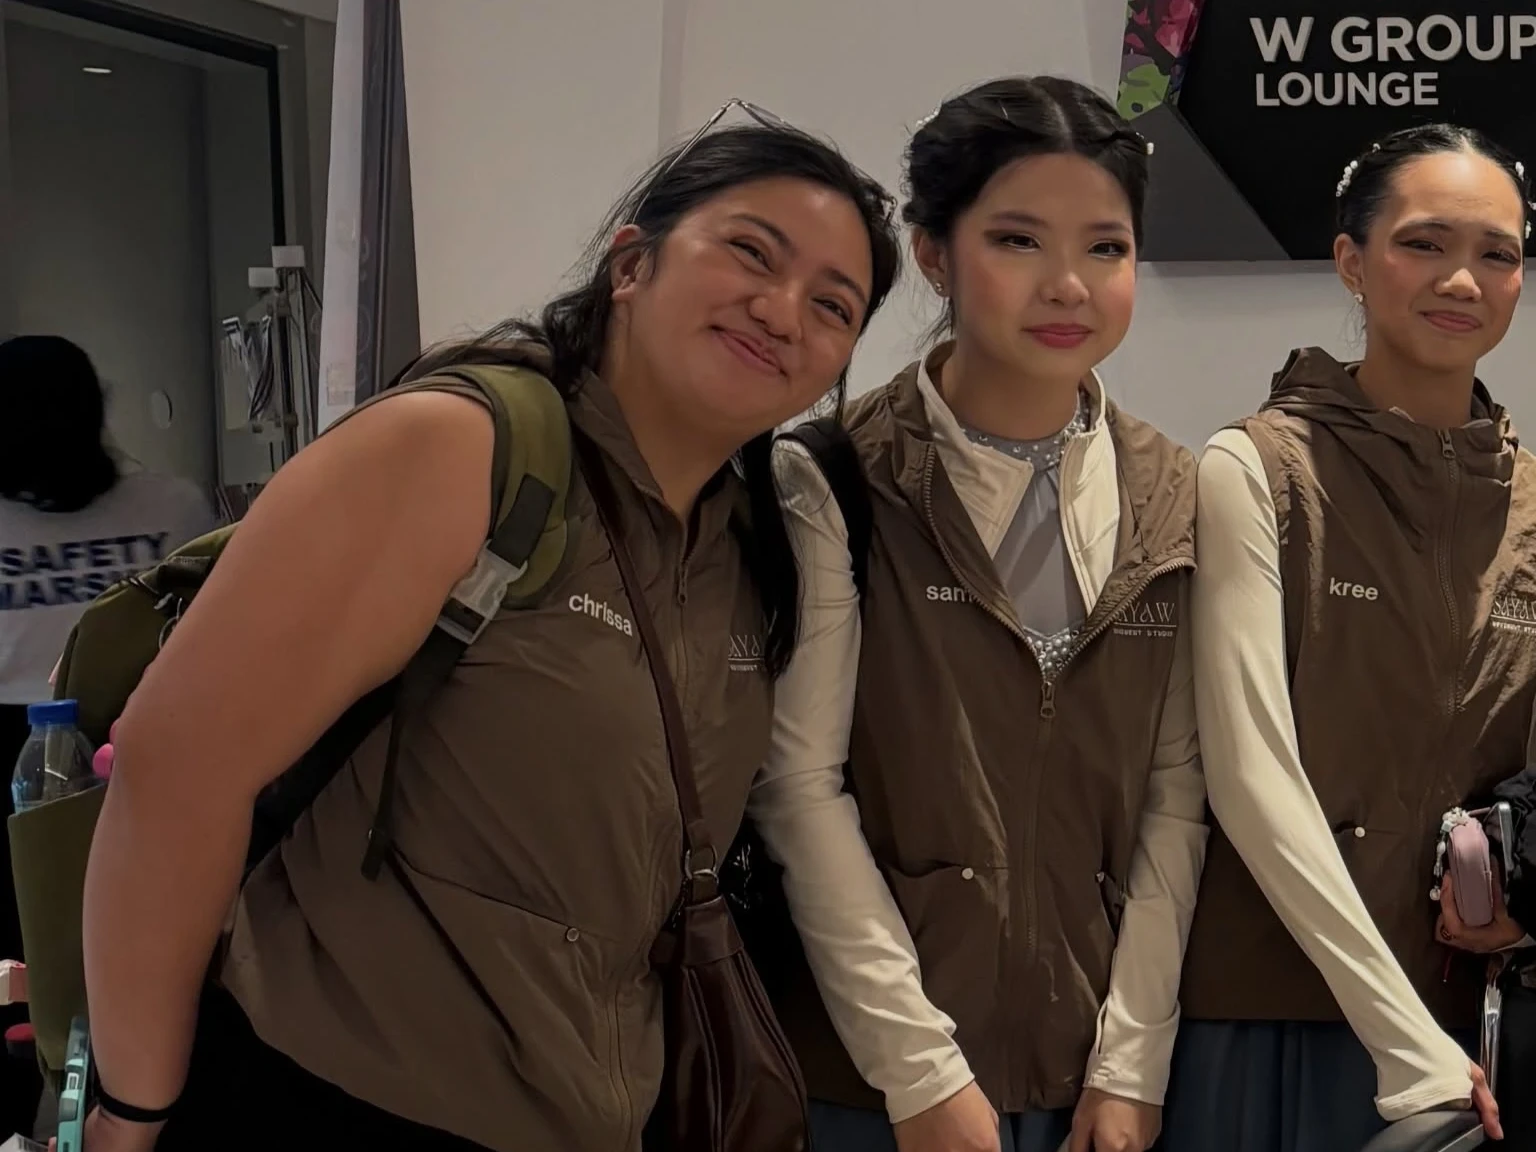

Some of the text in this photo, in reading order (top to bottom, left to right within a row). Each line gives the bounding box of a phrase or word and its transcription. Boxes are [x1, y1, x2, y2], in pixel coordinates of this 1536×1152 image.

[1249, 16, 1314, 62] W
[1256, 71, 1439, 107] LOUNGE
[0, 531, 169, 577] SAFETY
[1328, 577, 1379, 601] kree
[568, 593, 633, 637] chrissa
